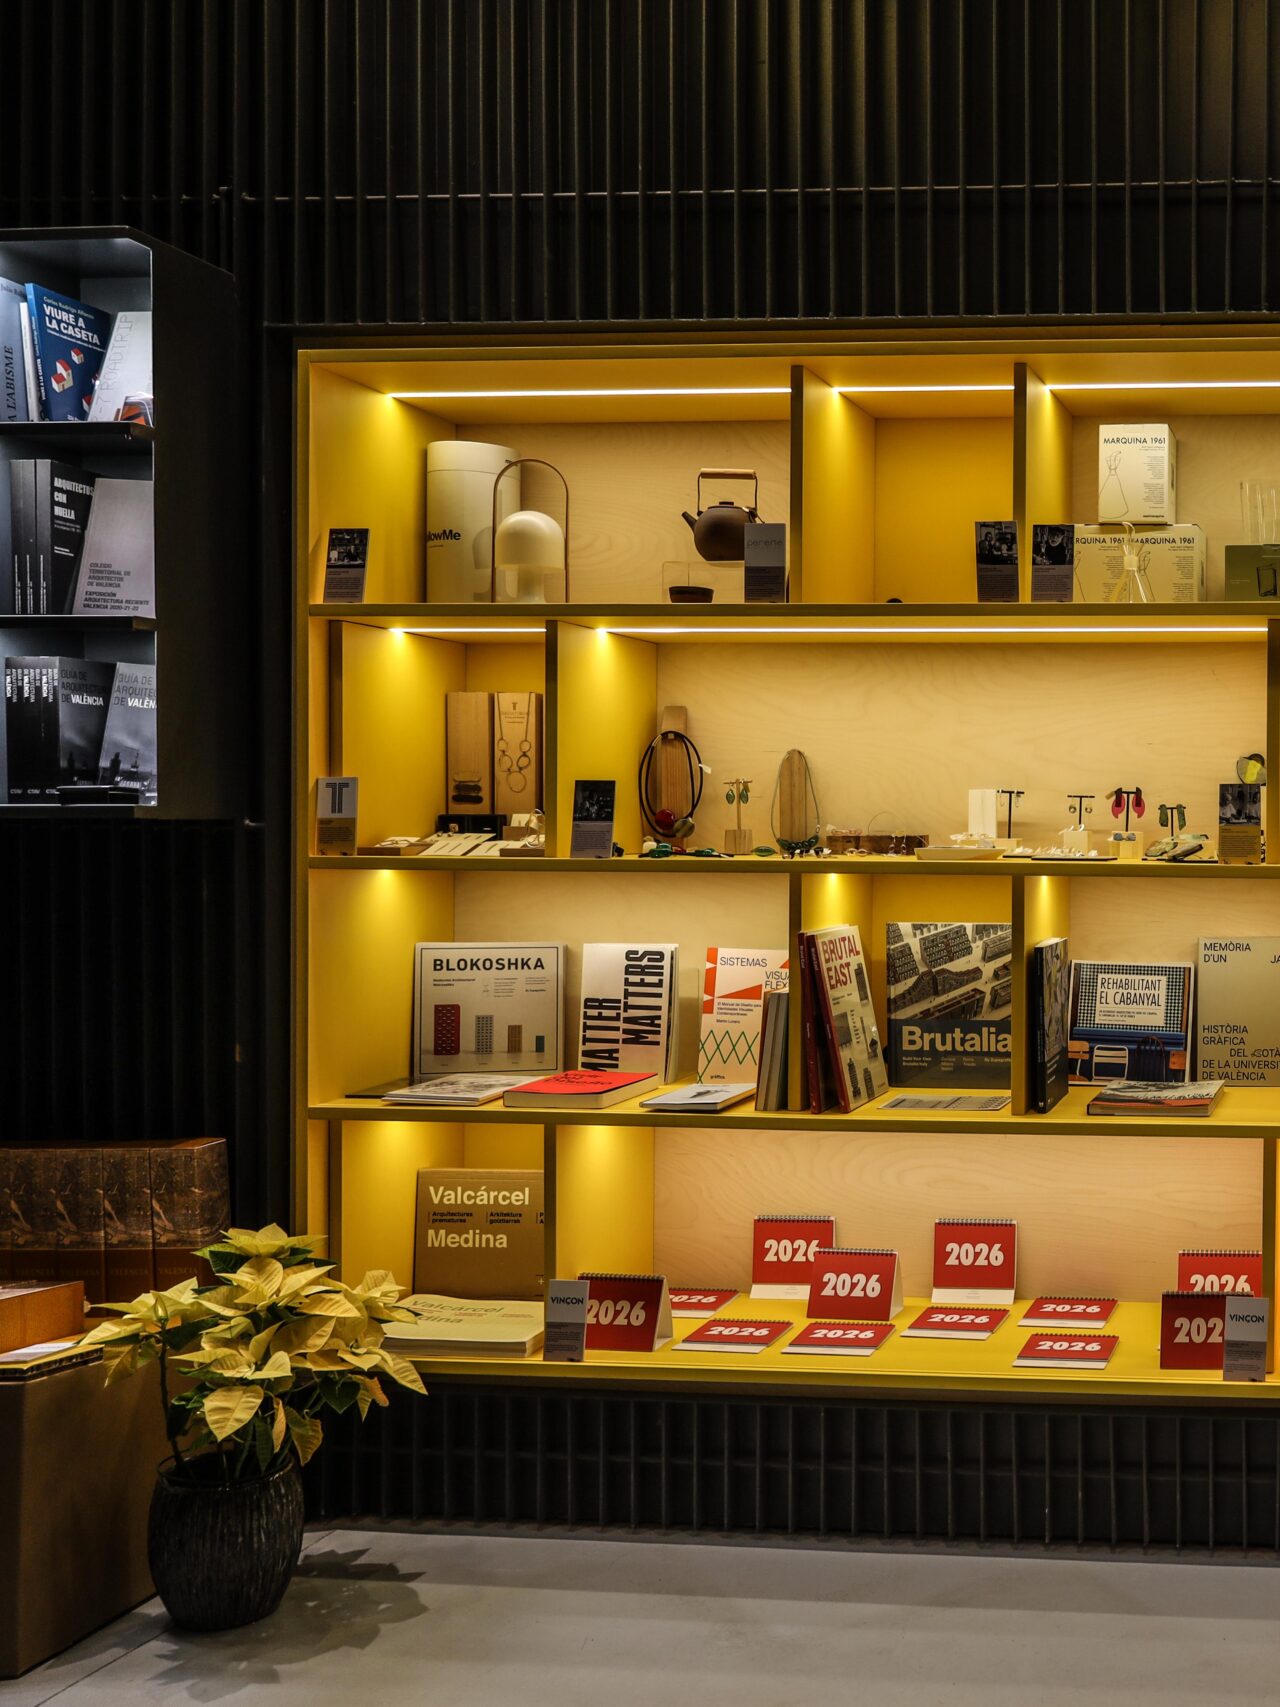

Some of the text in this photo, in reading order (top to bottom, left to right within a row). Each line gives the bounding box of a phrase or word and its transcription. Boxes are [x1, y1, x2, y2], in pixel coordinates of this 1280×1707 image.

[43, 304, 86, 329] VIURE A
[45, 316, 60, 331] LA
[60, 322, 101, 346] CASETA
[4, 345, 16, 410] L'ABISME
[1103, 437, 1166, 445] MARQUINA 1961
[54, 492, 67, 503] CON
[54, 506, 76, 519] HUELLA
[1075, 537, 1125, 545] RQUINA 1961
[1179, 537, 1195, 545] 1961
[142, 676, 152, 685] DE
[71, 692, 104, 706] VALÈNCIA
[113, 696, 126, 705] DE
[821, 934, 861, 964] BRUTAL
[1203, 941, 1252, 951] MEMÒRIA
[433, 957, 545, 971] BLOKOSHKA
[720, 956, 768, 968] SISTEMAS
[1203, 954, 1227, 963] D'UN
[826, 961, 852, 990] EAST
[1100, 977, 1162, 991] REHABILITANT
[622, 950, 665, 1046] MATTERS
[1099, 990, 1162, 1007] EL CABANYAL
[1202, 1023, 1249, 1034] HISTÒRIA
[902, 1025, 1012, 1052] Brutalia
[1202, 1034, 1246, 1045] GRÀFICA
[1229, 1048, 1248, 1058] DEL
[1202, 1059, 1215, 1068] DE
[1217, 1059, 1231, 1069] LA
[1202, 1069, 1266, 1081] DE VALÈNCIA
[428, 1185, 529, 1205] Valcárcel
[427, 1229, 508, 1248] Medina
[764, 1239, 820, 1263] 2026
[945, 1242, 1004, 1266] 2026
[821, 1272, 881, 1298] 2026
[1190, 1274, 1250, 1292] 2026
[551, 1296, 584, 1305] VINÇON
[585, 1299, 645, 1327] 2026
[1040, 1303, 1101, 1314] 2026
[927, 1314, 990, 1324] 2026
[1229, 1313, 1264, 1323] VINÇON
[704, 1326, 769, 1337] 2026
[809, 1329, 875, 1339] 2026
[1174, 1316, 1223, 1344] 202
[1035, 1340, 1101, 1352] 2026
